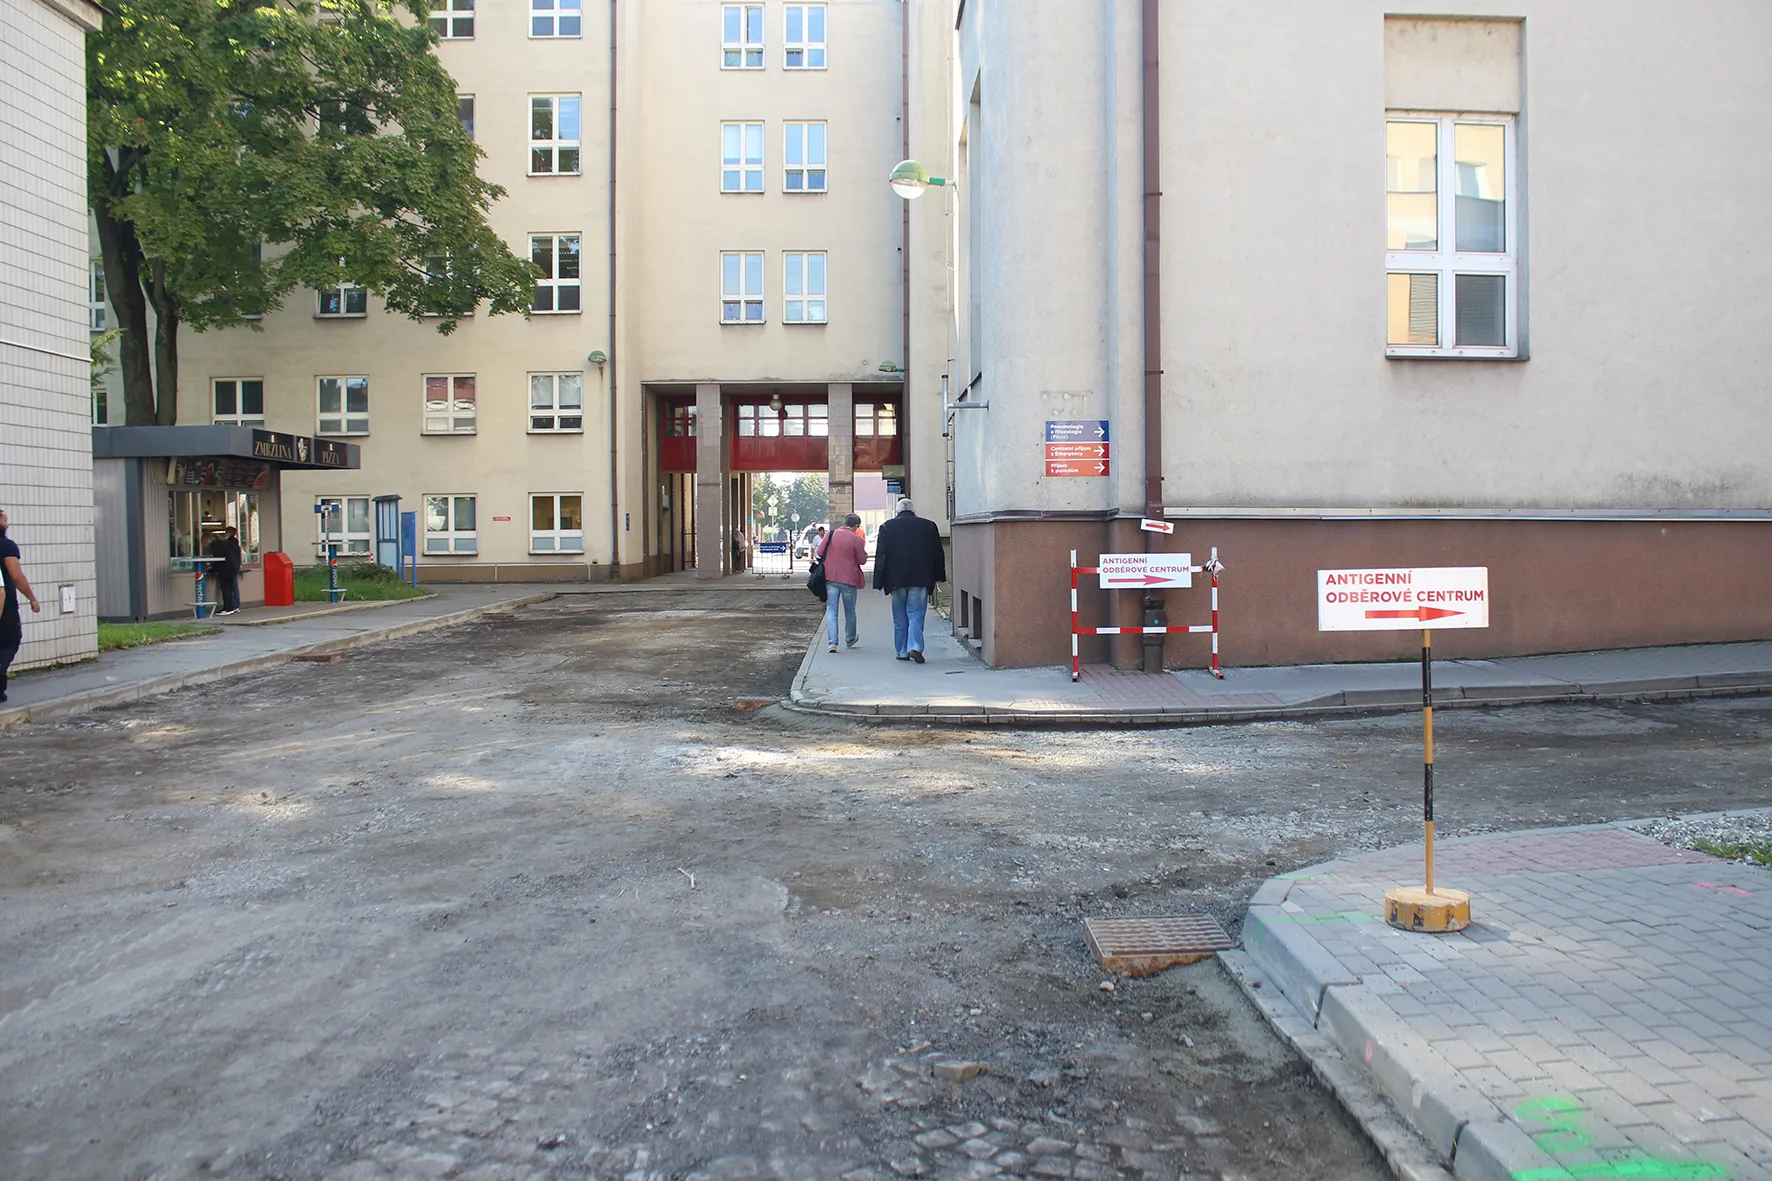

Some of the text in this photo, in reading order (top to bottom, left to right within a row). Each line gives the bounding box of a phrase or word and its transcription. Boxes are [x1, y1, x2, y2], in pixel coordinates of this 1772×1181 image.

[254, 441, 292, 459] ZMRZLINA
[322, 450, 340, 465] PIZZA
[1102, 556, 1148, 564] ANTIGENNÍ
[1102, 565, 1190, 573] ODBĚROVÉ CENTRUM
[1326, 570, 1413, 585] ANTIGENNÍ
[1326, 588, 1484, 603] ODBĚROVÉ CENTRUM
